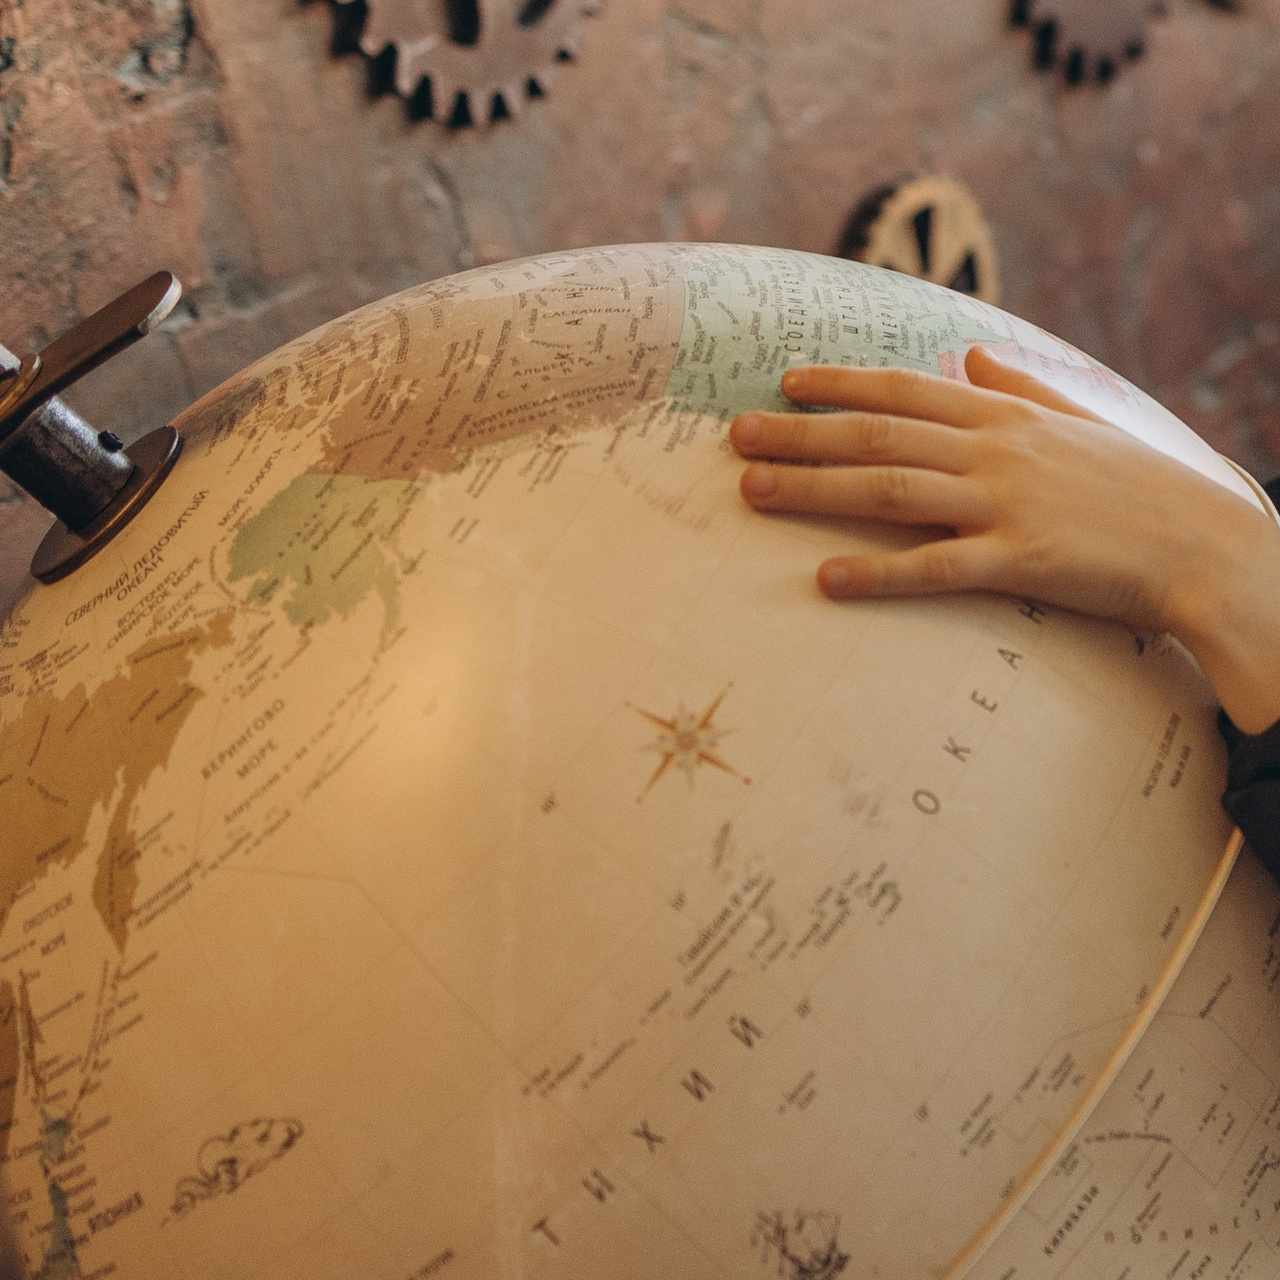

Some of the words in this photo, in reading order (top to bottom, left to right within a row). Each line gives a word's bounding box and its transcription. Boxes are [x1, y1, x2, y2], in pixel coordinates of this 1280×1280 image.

[542, 306, 631, 319] САСКАЧЕВАН
[836, 286, 858, 334] ШТАТЫ
[214, 494, 250, 528] МОРЕ
[61, 569, 133, 627] СЕВЕРНЫЙ
[129, 488, 211, 575] ЛЕДОВИТЫЙ
[112, 553, 167, 603] ОКЕАН
[168, 555, 204, 589] МОРЕ
[166, 603, 197, 632] МОРЕ
[910, 600, 1046, 817] ОКЕАН
[196, 696, 289, 781] БЕРИНГОВО
[232, 737, 279, 781] МОРЕ
[1038, 1182, 1105, 1258] КИРИБАТИ
